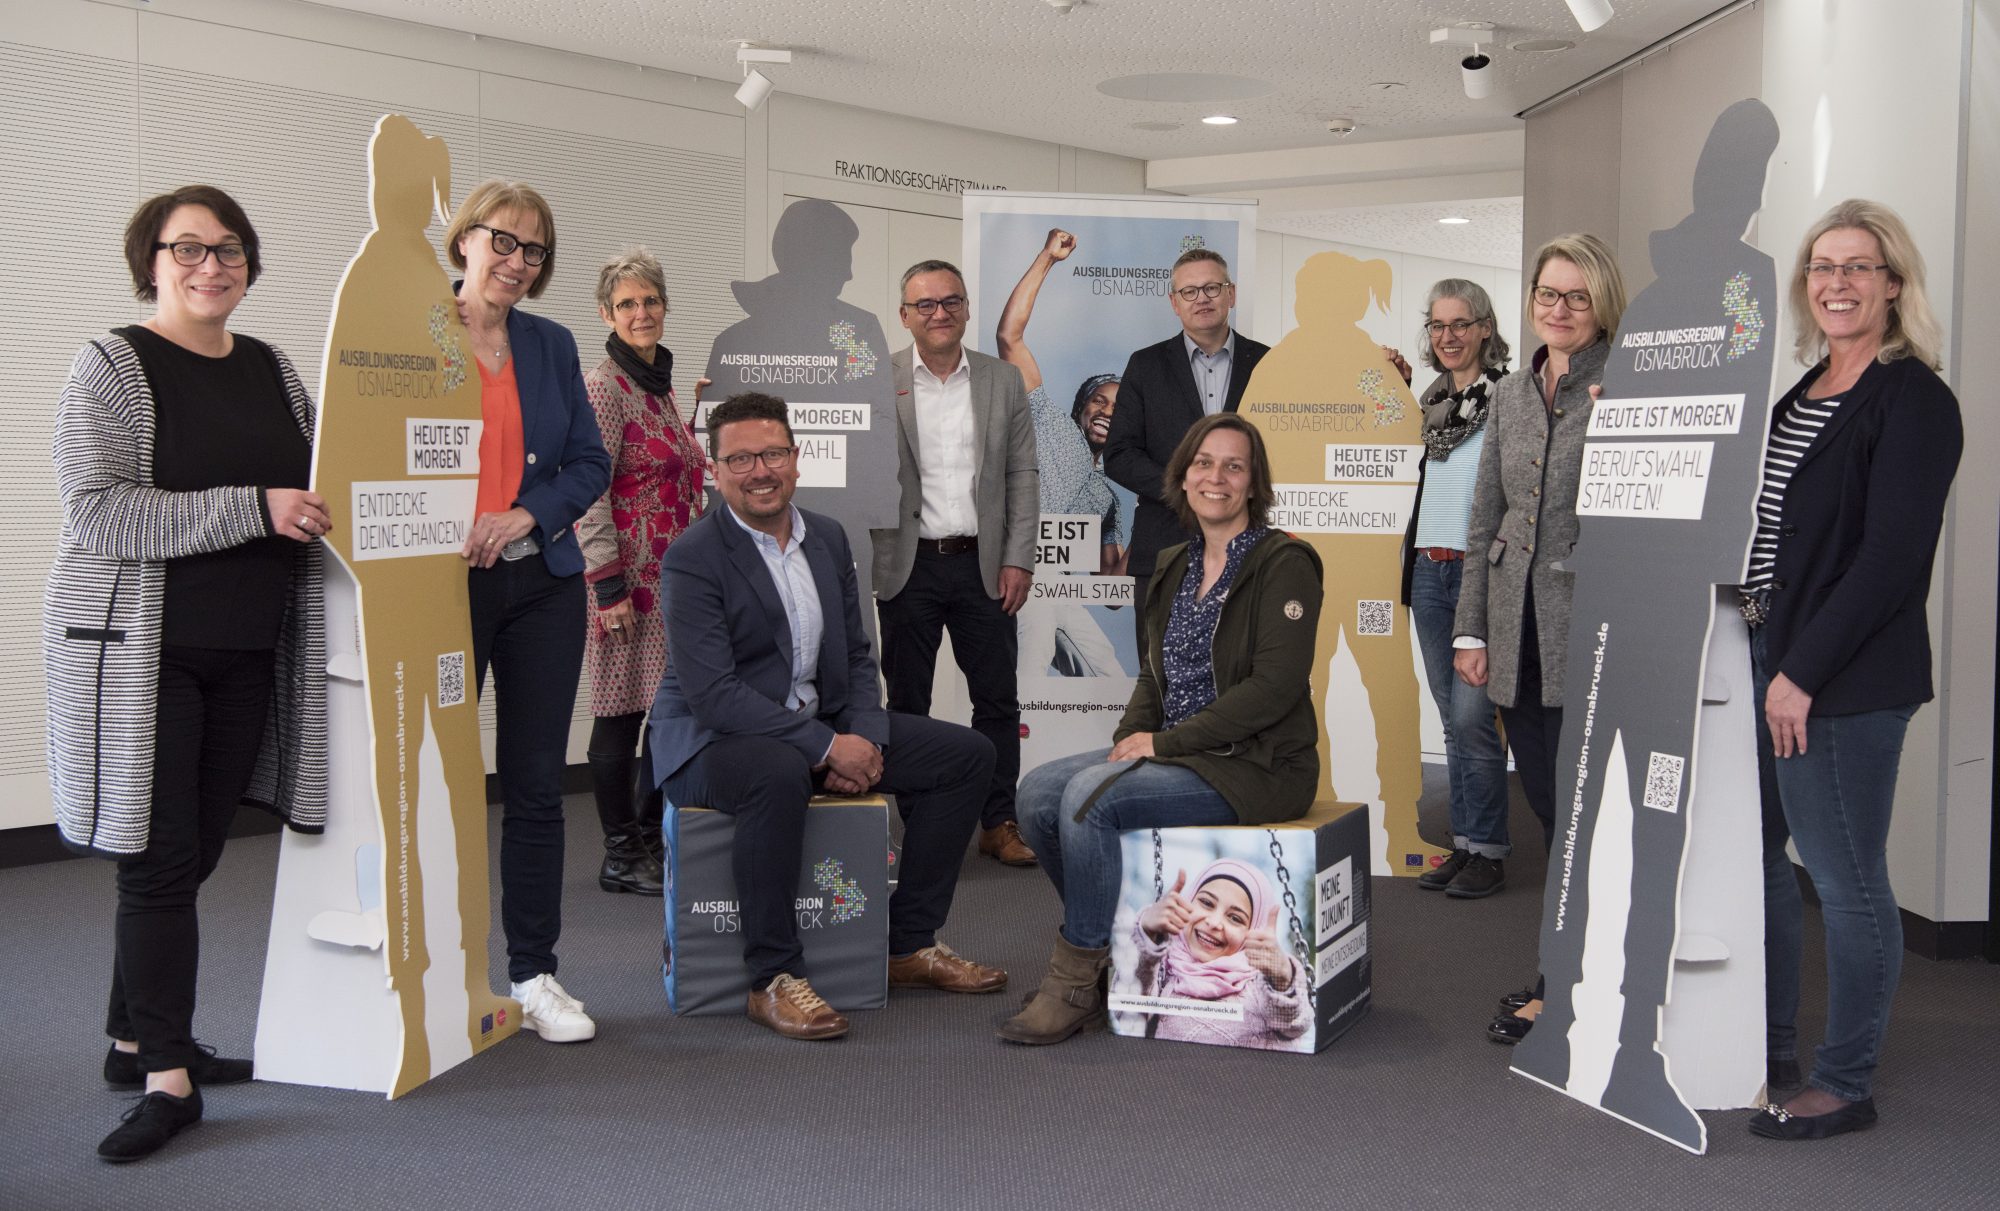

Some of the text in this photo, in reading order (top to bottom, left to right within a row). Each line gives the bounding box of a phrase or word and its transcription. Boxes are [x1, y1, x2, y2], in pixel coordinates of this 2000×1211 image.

[1073, 266, 1172, 279] AUSBILDUNGSREGI
[1092, 278, 1171, 296] OSNABRÜ
[1621, 325, 1726, 348] AUSBILDUNGSREGION
[339, 349, 437, 372] AUSBILDUNGSREGION
[720, 354, 838, 367] AUSBILDUNGSREGION
[1634, 343, 1724, 372] OSNABRÜCK
[357, 370, 438, 399] OSNABRÜCK
[740, 366, 838, 385] OSNABRÜCK
[794, 409, 863, 425] MORGEN
[1250, 403, 1366, 414] AUSBILDUNGSREGION
[1596, 403, 1736, 429] HEUTE IST MORGEN
[1269, 414, 1366, 432] OSNABRÜCK
[414, 425, 470, 445] HEUTE IST
[414, 449, 461, 469] MORGEN
[1334, 449, 1408, 463] HEUTE IST
[1588, 450, 1705, 478] BERUFSWAHL
[1334, 464, 1394, 478] MORGEN
[359, 492, 428, 518] ENTDECKE
[1274, 491, 1349, 507] NTDECKE
[1582, 482, 1663, 511] STARTEN!
[1317, 511, 1396, 528] CHANCEN!
[360, 520, 464, 550] DEINE CHANCEN!
[1058, 521, 1089, 540] IST
[1092, 583, 1136, 599] START
[1018, 701, 1128, 713] usbildungsregion-osn
[1555, 622, 1609, 932] www.ausbildungsregion-osnabrueck.de
[394, 660, 409, 962] www.ausbildungsregion-osnabrueck.de
[1321, 872, 1341, 904] MEINE
[1321, 895, 1350, 933] ZUKUNFT
[1119, 999, 1238, 1014] www.ausbildungsregion-osnabrueck.de
